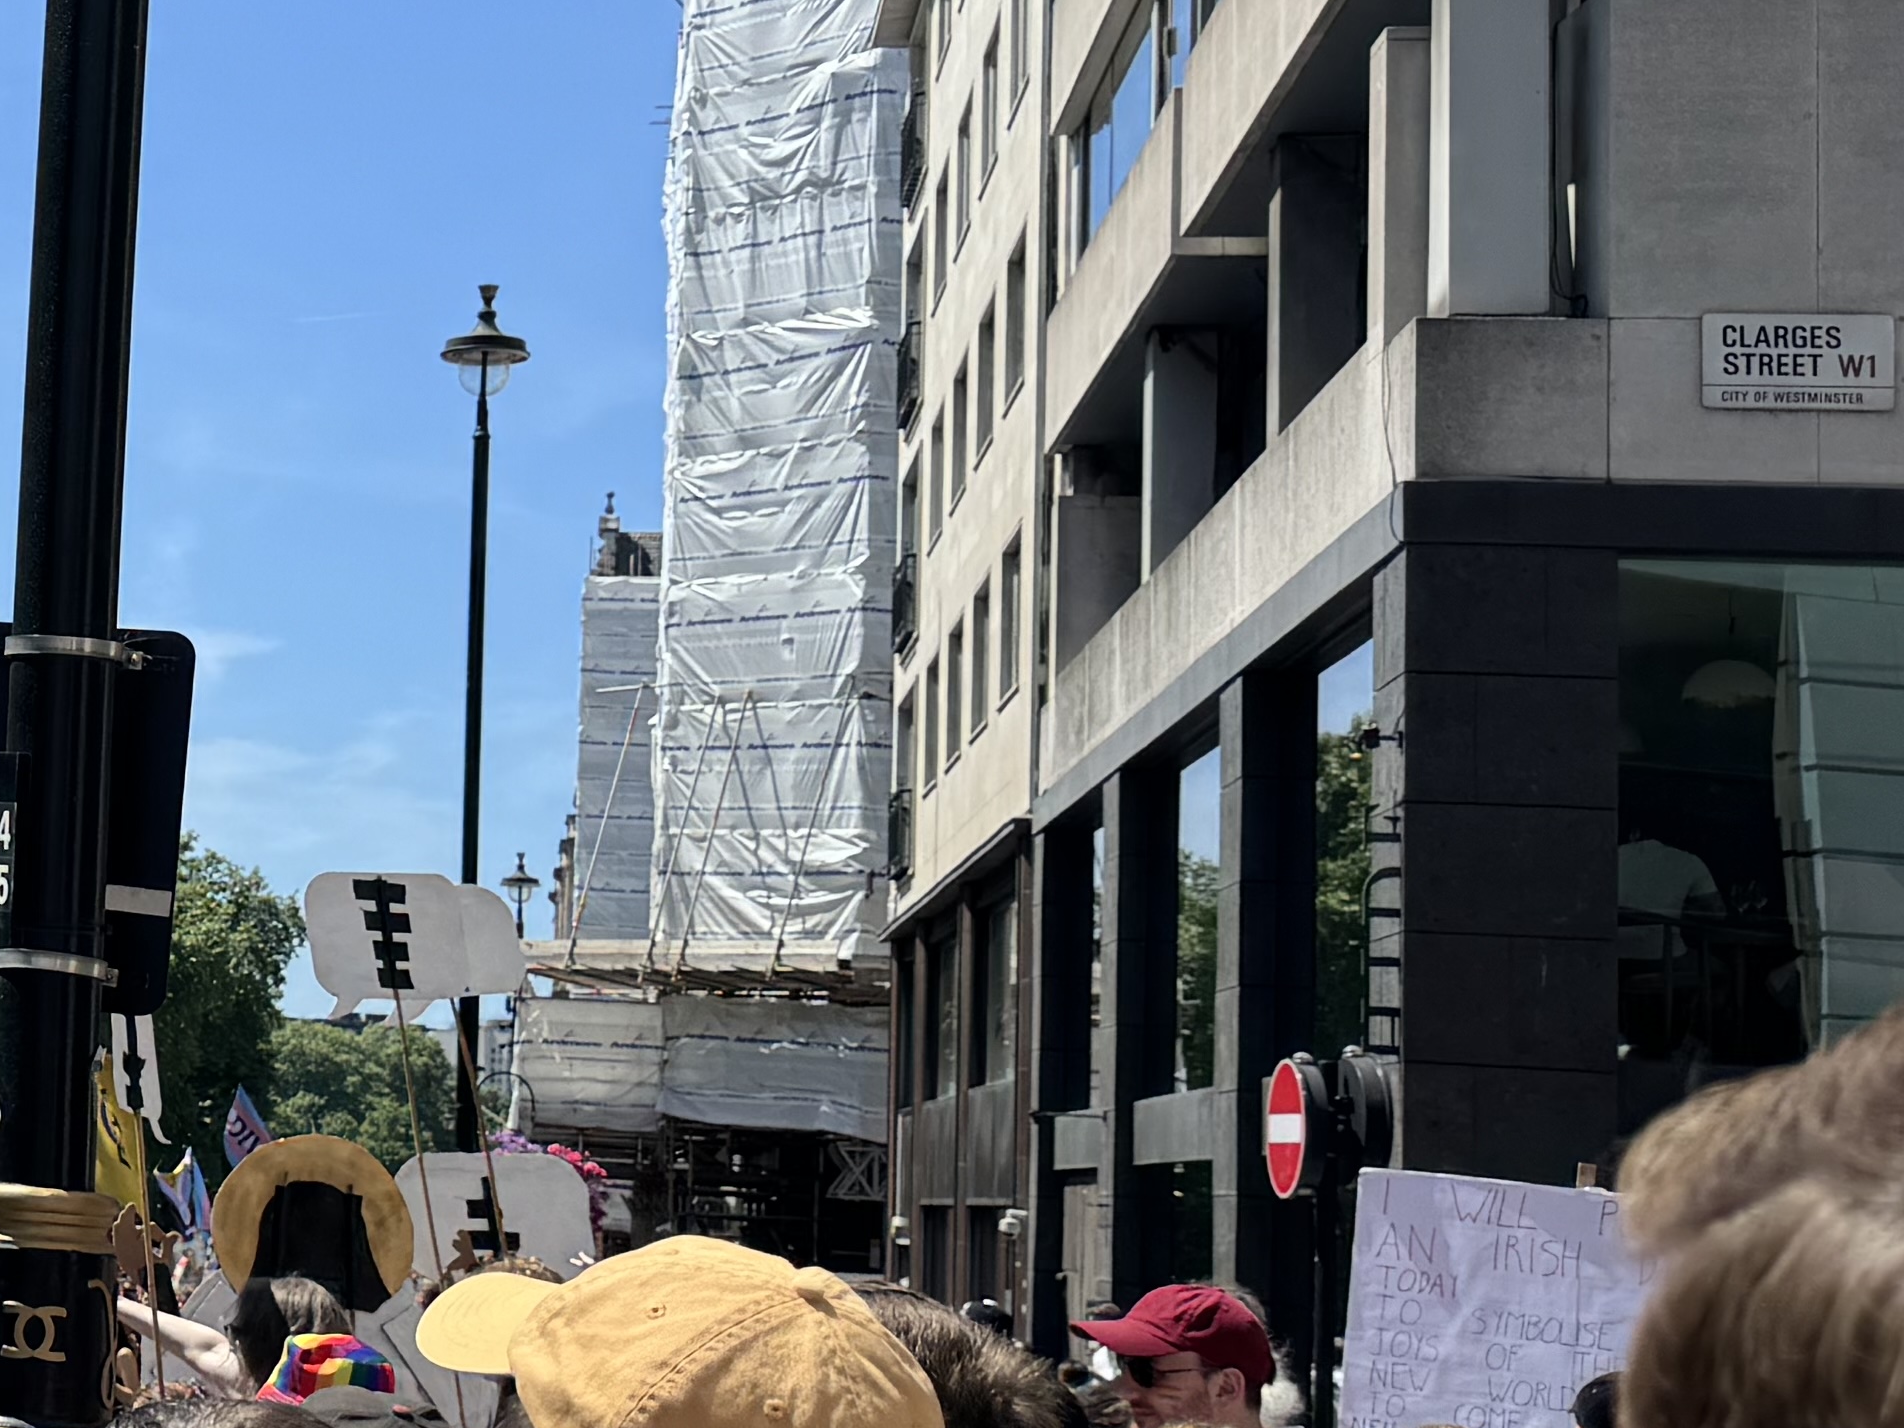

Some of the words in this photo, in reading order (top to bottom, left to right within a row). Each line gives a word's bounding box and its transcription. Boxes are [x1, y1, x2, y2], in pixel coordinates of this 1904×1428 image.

[1722, 324, 1842, 350] CLARGES
[1722, 352, 1824, 377] STREET
[1838, 353, 1877, 378] W1
[1721, 390, 1749, 402] CITY
[1753, 391, 1769, 403] OF
[1773, 392, 1864, 405] WESTMINSTER
[1383, 1178, 1390, 1216] I
[1451, 1183, 1537, 1231] WILL
[1375, 1222, 1437, 1264] AN
[1493, 1232, 1583, 1278] IRISH
[1375, 1264, 1458, 1299] TODAY
[1375, 1294, 1423, 1325] TO
[1369, 1327, 1439, 1363] JOYS
[1485, 1343, 1524, 1372] OF
[1369, 1359, 1431, 1392] NEW
[1369, 1391, 1406, 1418] TO
